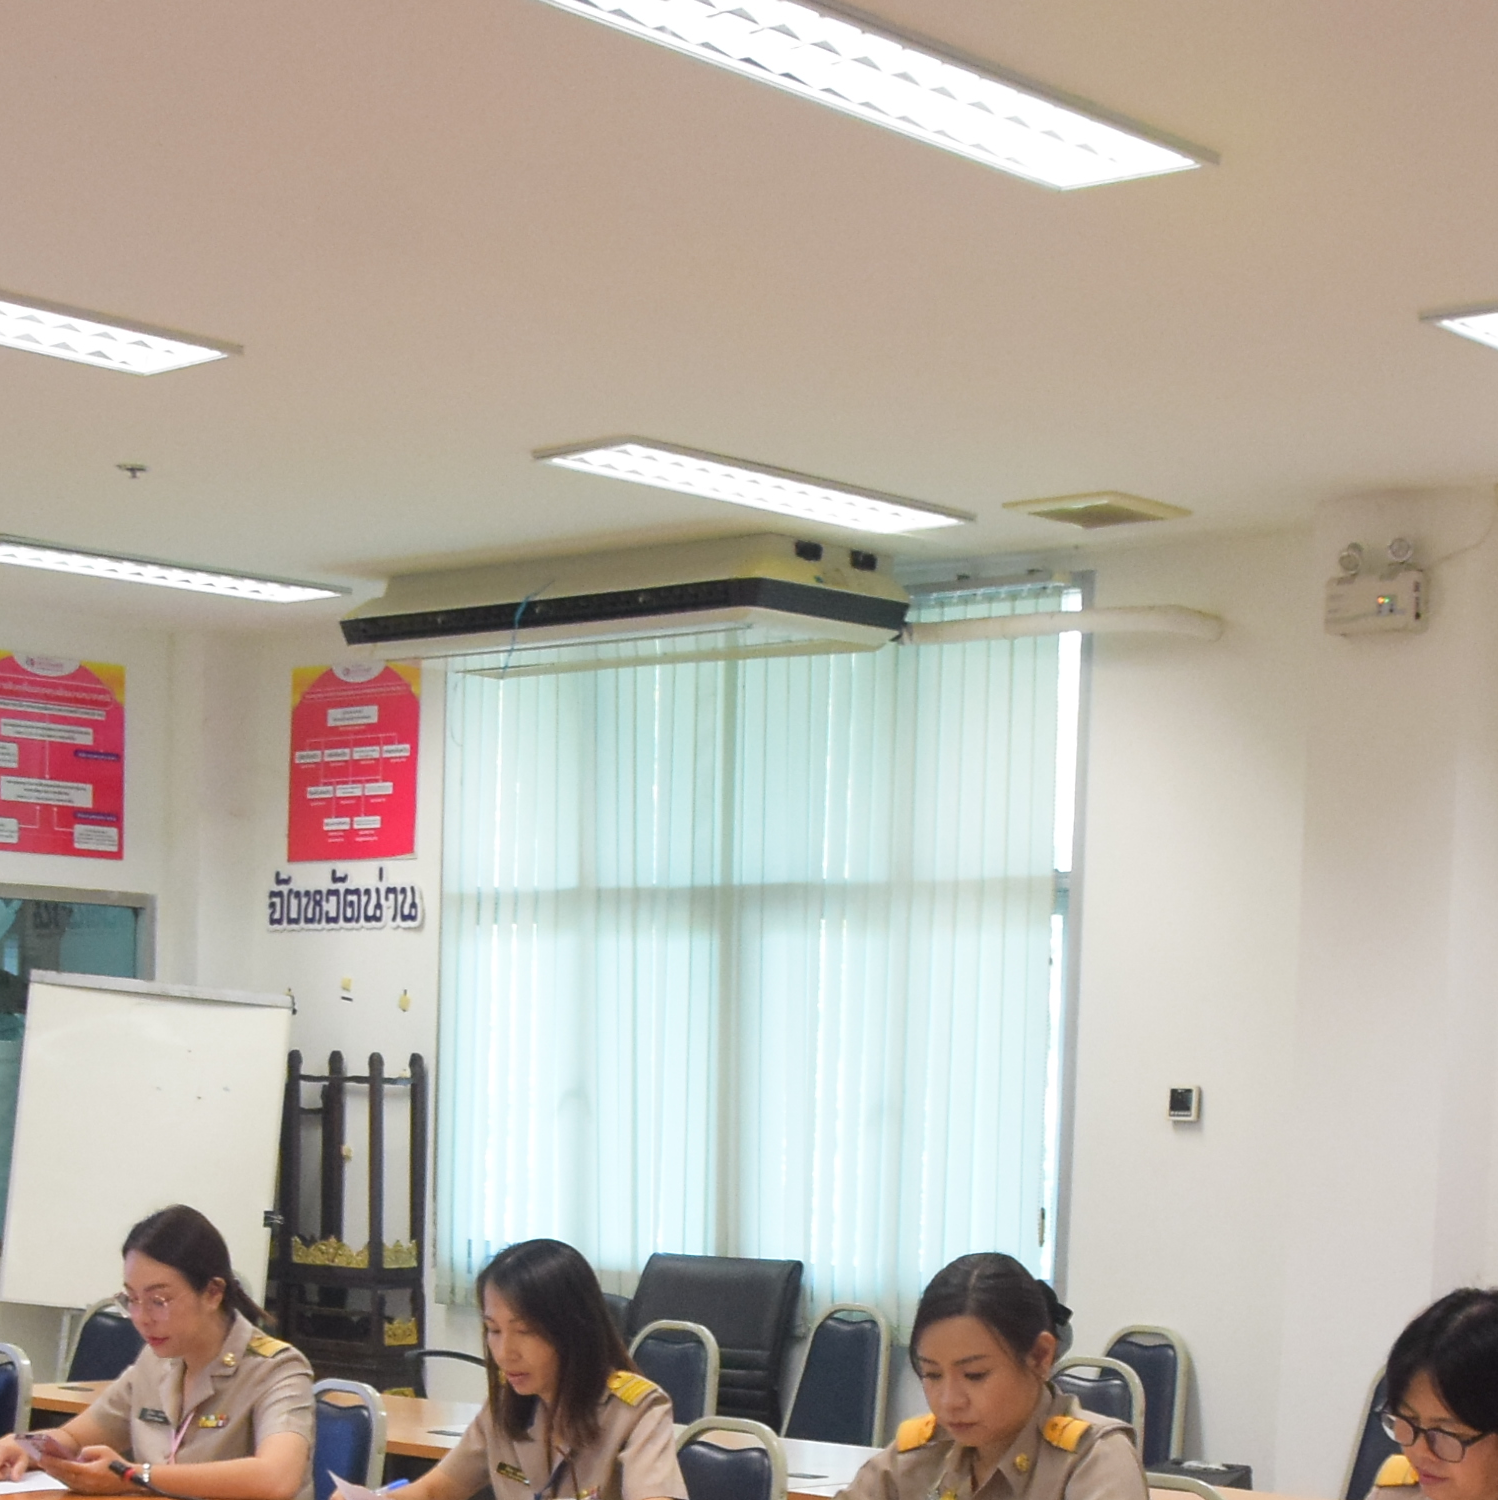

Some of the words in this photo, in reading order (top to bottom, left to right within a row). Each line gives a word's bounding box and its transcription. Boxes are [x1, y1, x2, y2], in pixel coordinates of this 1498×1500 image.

[268, 866, 418, 926] จังหวัดน่าน
